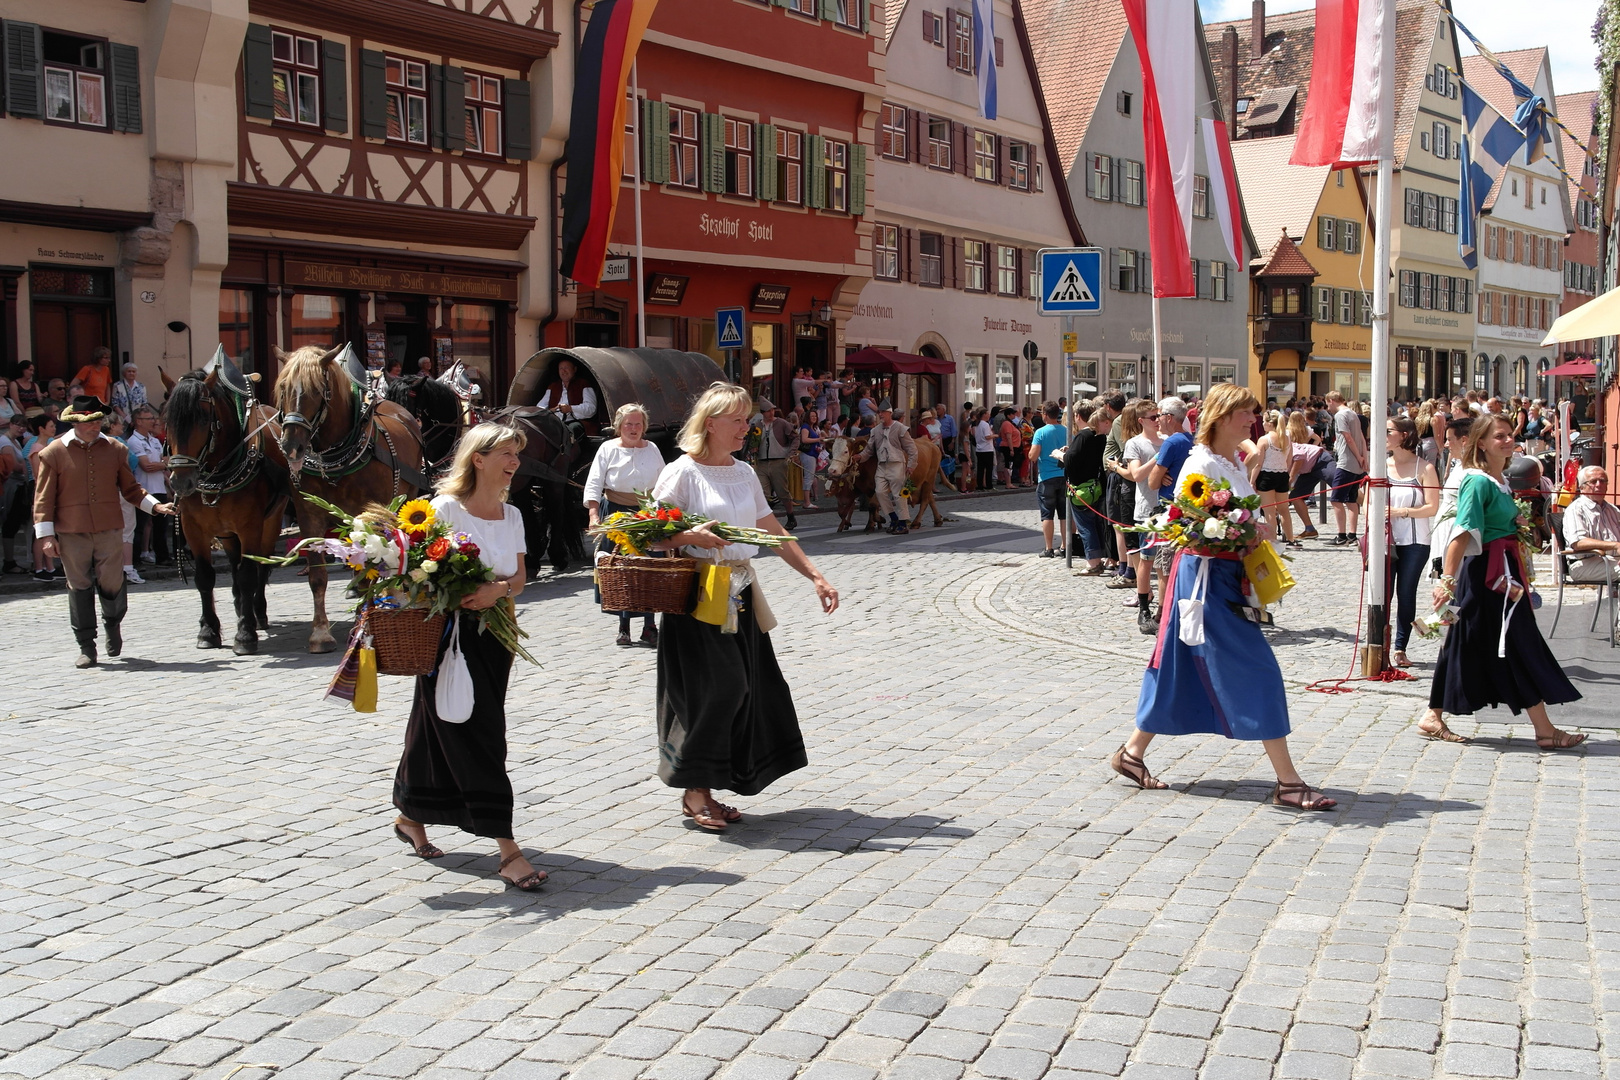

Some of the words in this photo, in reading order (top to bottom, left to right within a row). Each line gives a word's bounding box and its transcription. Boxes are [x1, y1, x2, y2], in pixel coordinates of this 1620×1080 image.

[699, 213, 740, 239] Hezelhof
[748, 220, 774, 242] Hotel
[38, 247, 56, 257] Haus
[304, 264, 343, 285] Wilhelm
[606, 263, 626, 277] Hotel
[983, 316, 1008, 332] Juwelier
[1010, 319, 1032, 335] Dragon
